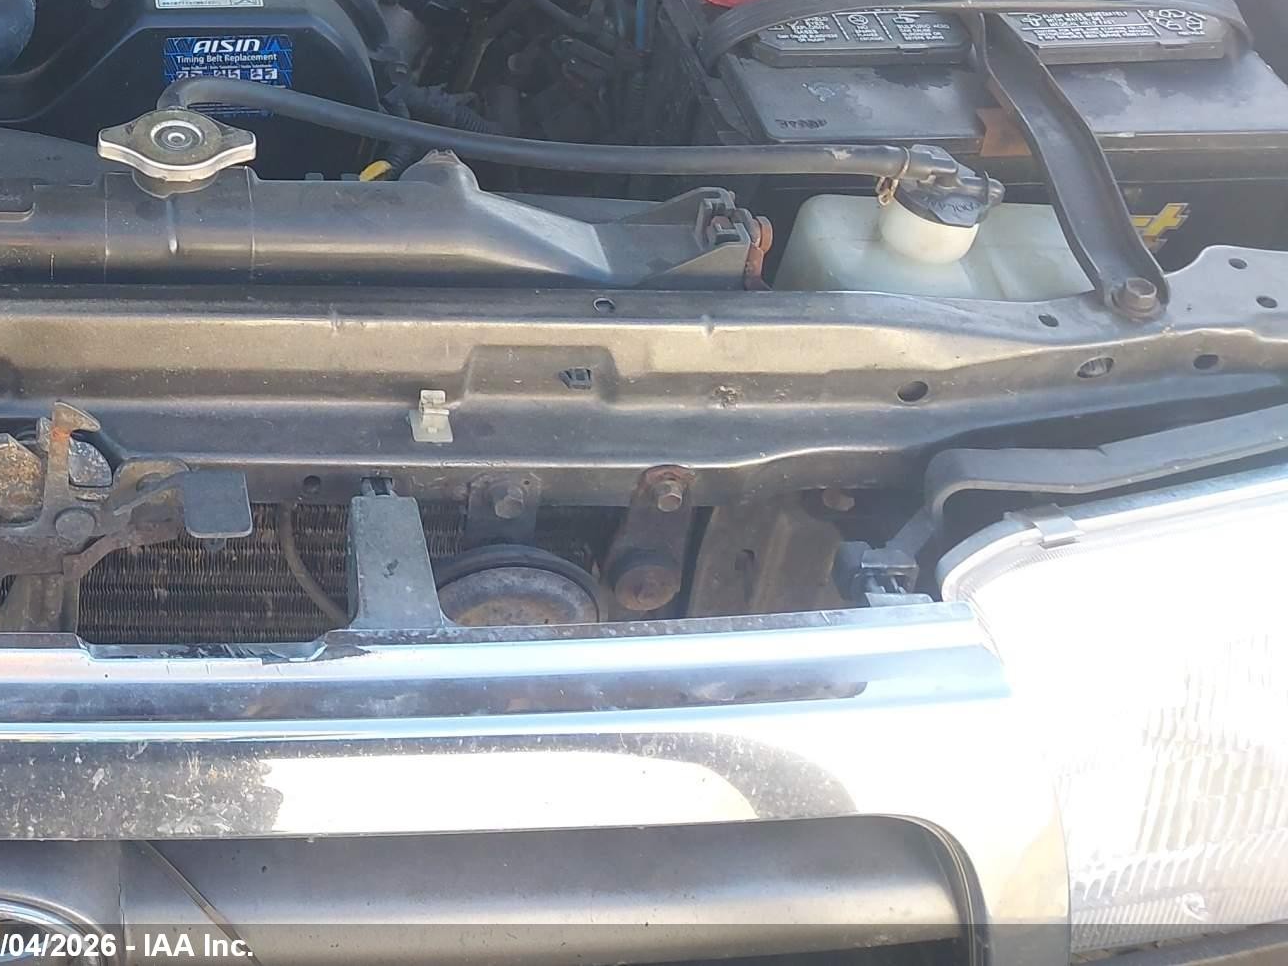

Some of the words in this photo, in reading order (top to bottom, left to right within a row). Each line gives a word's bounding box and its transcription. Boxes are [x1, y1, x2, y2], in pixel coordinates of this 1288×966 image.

[193, 38, 260, 54] AISIN
[176, 55, 204, 64] Timing
[206, 55, 223, 63] Belt
[224, 54, 277, 63] Replacement
